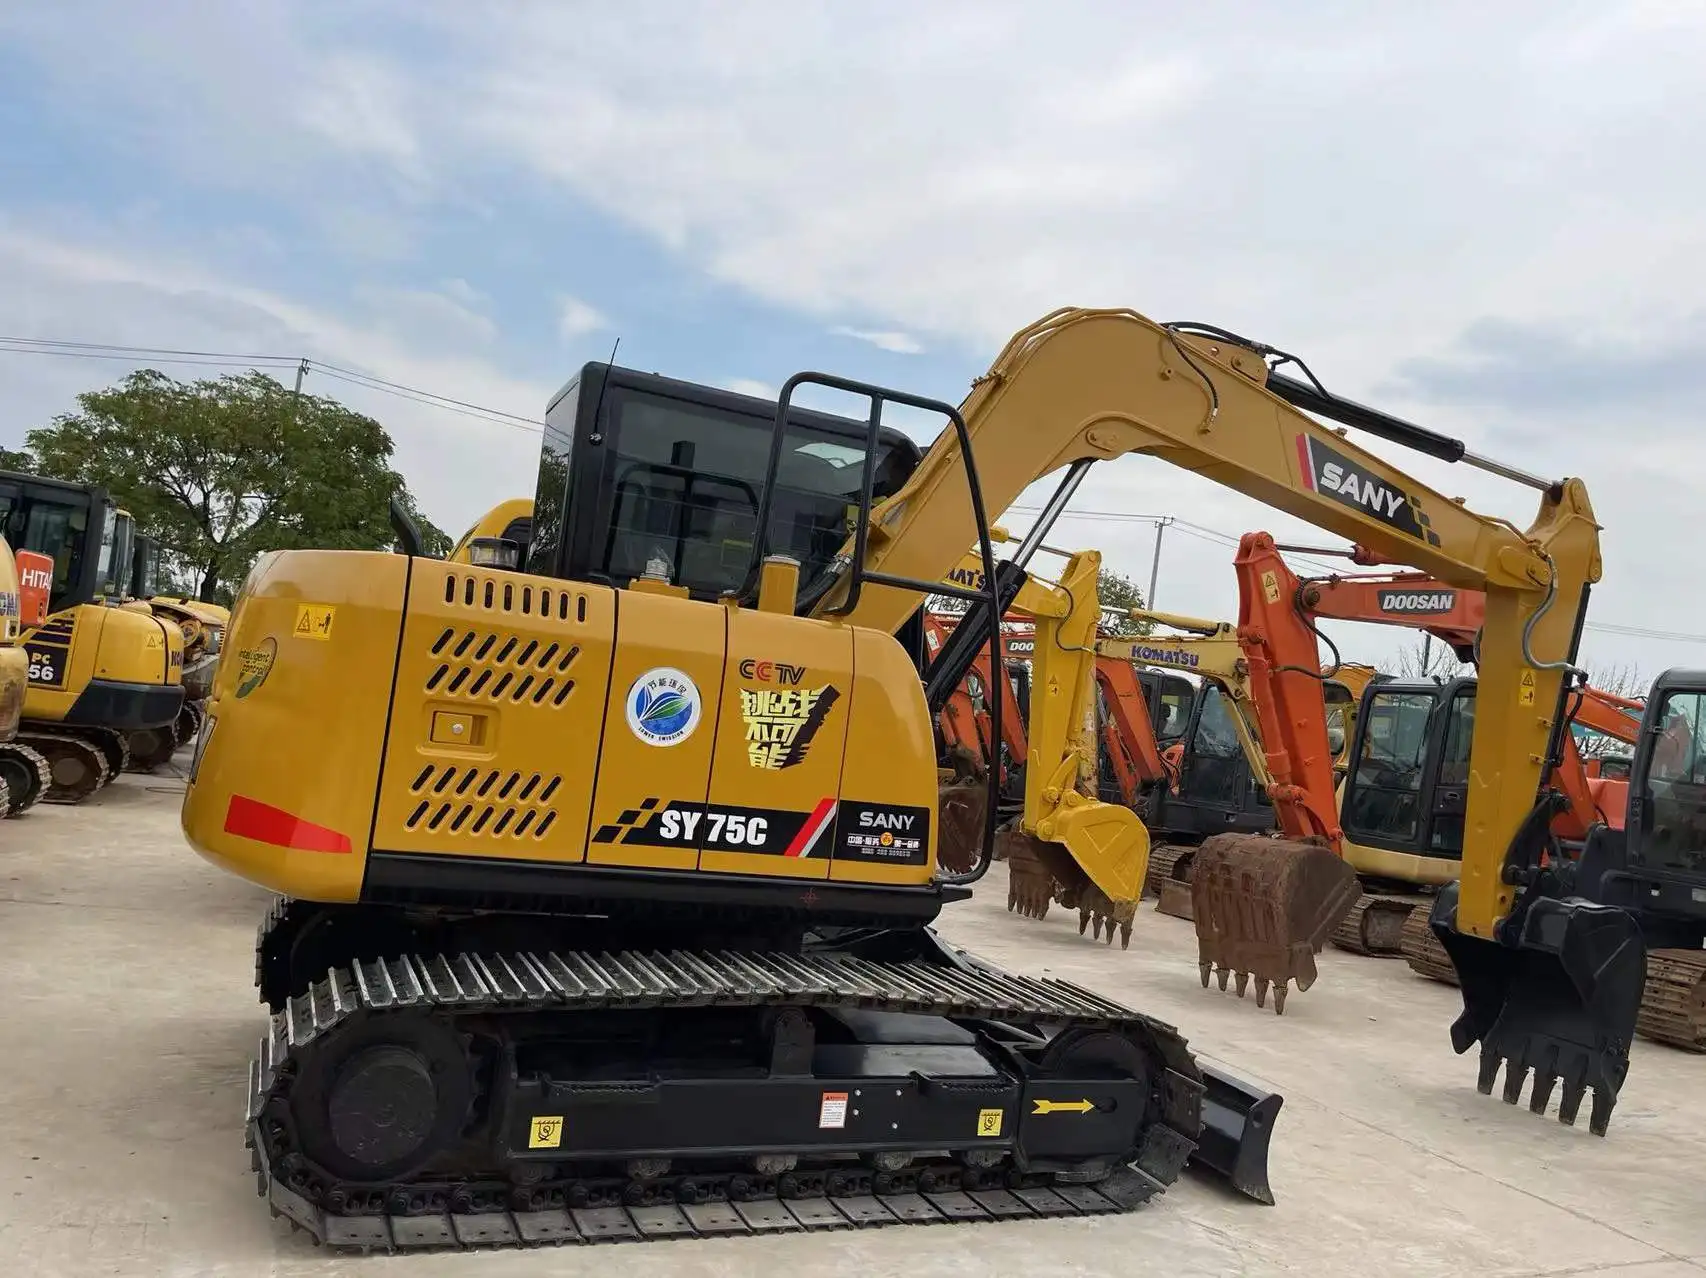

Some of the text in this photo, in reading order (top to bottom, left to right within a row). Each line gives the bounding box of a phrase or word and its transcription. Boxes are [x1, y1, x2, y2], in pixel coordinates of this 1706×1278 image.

[1320, 462, 1405, 519] SANY
[21, 567, 52, 591] HITA
[1382, 593, 1453, 610] DOOSAN
[31, 652, 51, 664] PC
[1131, 645, 1199, 667] KOMATSU
[28, 664, 54, 680] 56
[740, 659, 806, 686] CCTV
[659, 809, 768, 846] SY 75C
[859, 811, 915, 830] SANY
